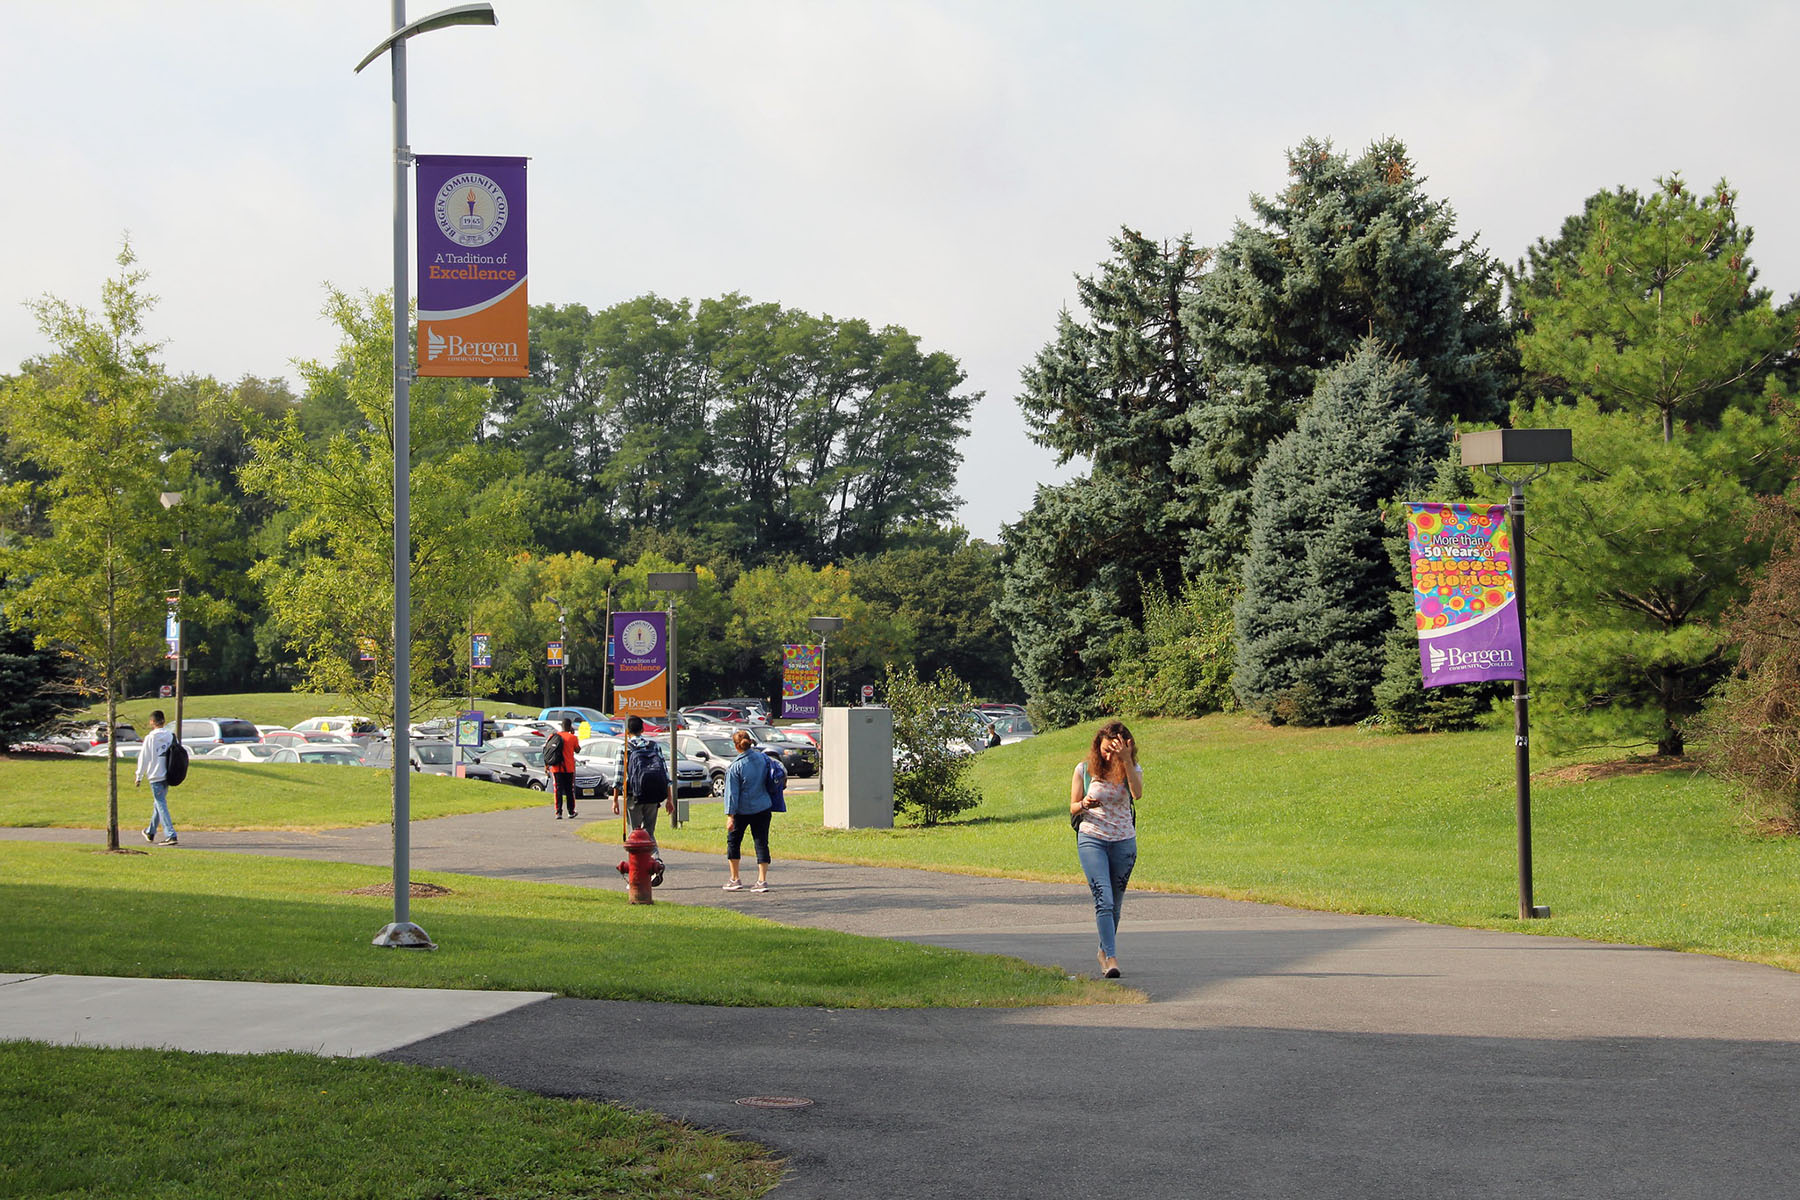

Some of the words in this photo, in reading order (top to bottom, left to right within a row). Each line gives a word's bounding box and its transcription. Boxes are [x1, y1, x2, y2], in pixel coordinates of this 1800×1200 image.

[442, 175, 499, 197] COMMUNITY
[438, 199, 456, 238] BERGEN
[488, 196, 506, 239] COLLEGE
[434, 254, 445, 264] A
[445, 252, 494, 265] Tradition
[496, 252, 508, 265] of
[429, 264, 517, 281] Excellence
[447, 335, 519, 364] Bergen
[1432, 534, 1460, 546] More
[1461, 534, 1485, 546] than
[1424, 546, 1442, 558] 50
[1444, 546, 1481, 558] Years
[1483, 547, 1496, 558] of
[1415, 558, 1508, 573] Success
[1421, 570, 1506, 588] Stories
[551, 648, 559, 658] Y
[1447, 647, 1514, 670] Bergen
[1448, 663, 1481, 672] COMMUNITY
[628, 697, 662, 710] Bergen
[792, 704, 815, 713] Bergen
